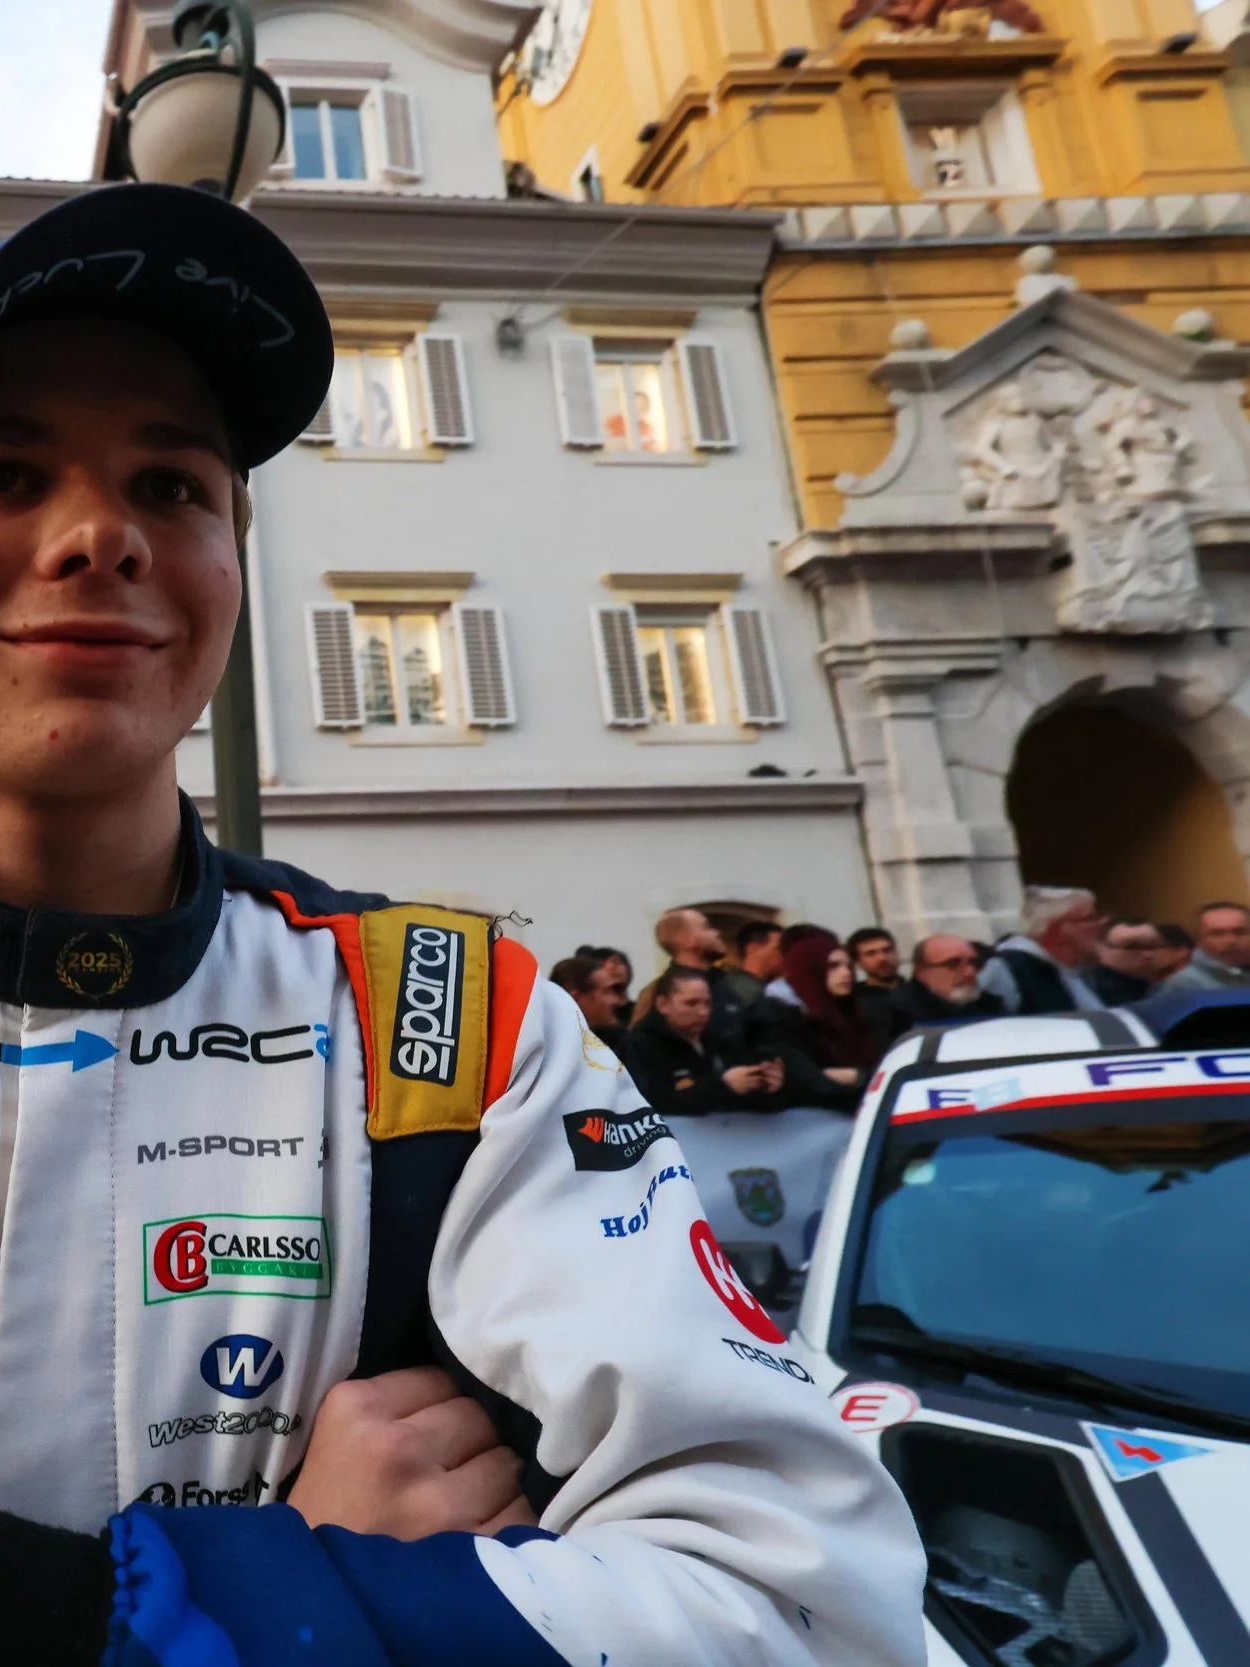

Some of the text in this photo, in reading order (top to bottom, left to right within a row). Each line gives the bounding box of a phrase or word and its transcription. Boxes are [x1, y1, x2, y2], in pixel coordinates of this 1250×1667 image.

[67, 951, 122, 968] 2025
[397, 927, 455, 1075] sparco
[137, 1135, 305, 1165] M-SPORT
[216, 1342, 279, 1387] W
[840, 1394, 888, 1422] E
